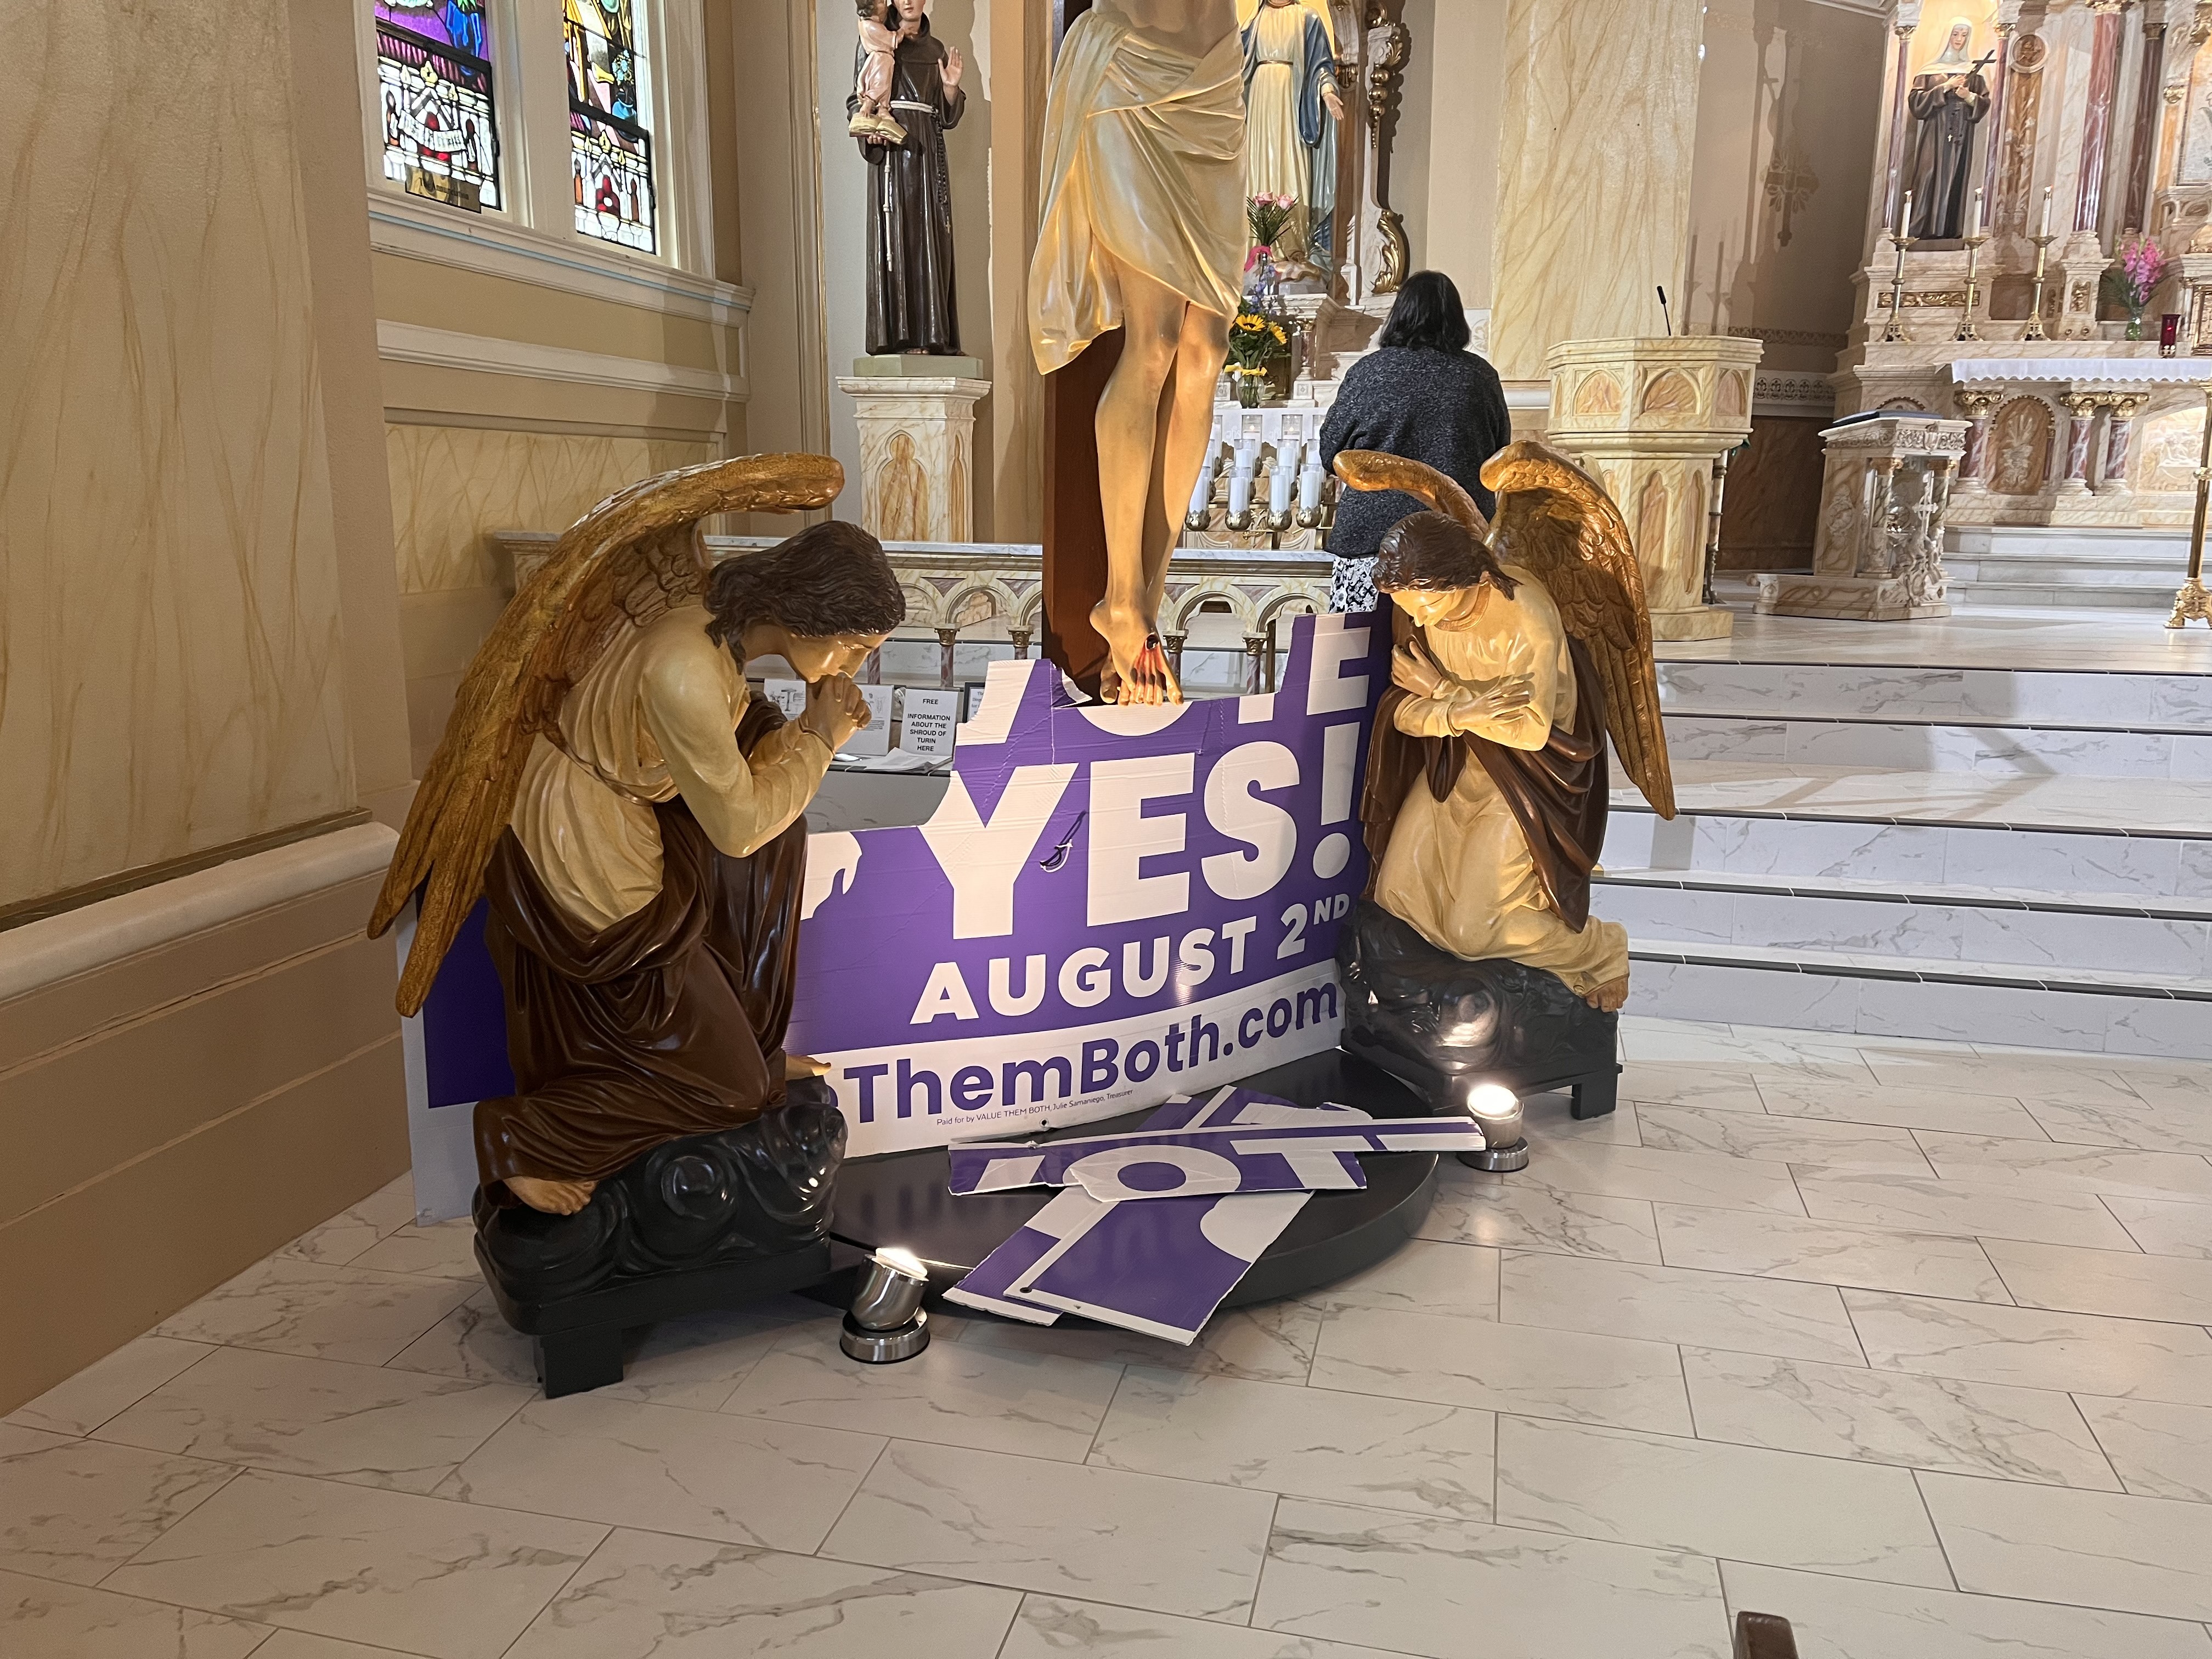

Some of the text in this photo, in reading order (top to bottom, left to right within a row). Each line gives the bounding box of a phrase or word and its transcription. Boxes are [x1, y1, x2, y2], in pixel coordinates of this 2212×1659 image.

[918, 721, 1359, 940] YES!
[909, 893, 1350, 1025] AUGUST 2ND
[827, 982, 1338, 1124] ThemBoth.com
[936, 1118, 953, 1126] Paid
[966, 1115, 975, 1124] by
[976, 1111, 1002, 1121] VALUE
[1003, 1108, 1028, 1118] THEM
[1029, 1105, 1052, 1114] BOTH,
[1053, 1102, 1068, 1111] Julie
[1069, 1097, 1105, 1108] Samaniego,
[1105, 1089, 1133, 1100] Treasurer
